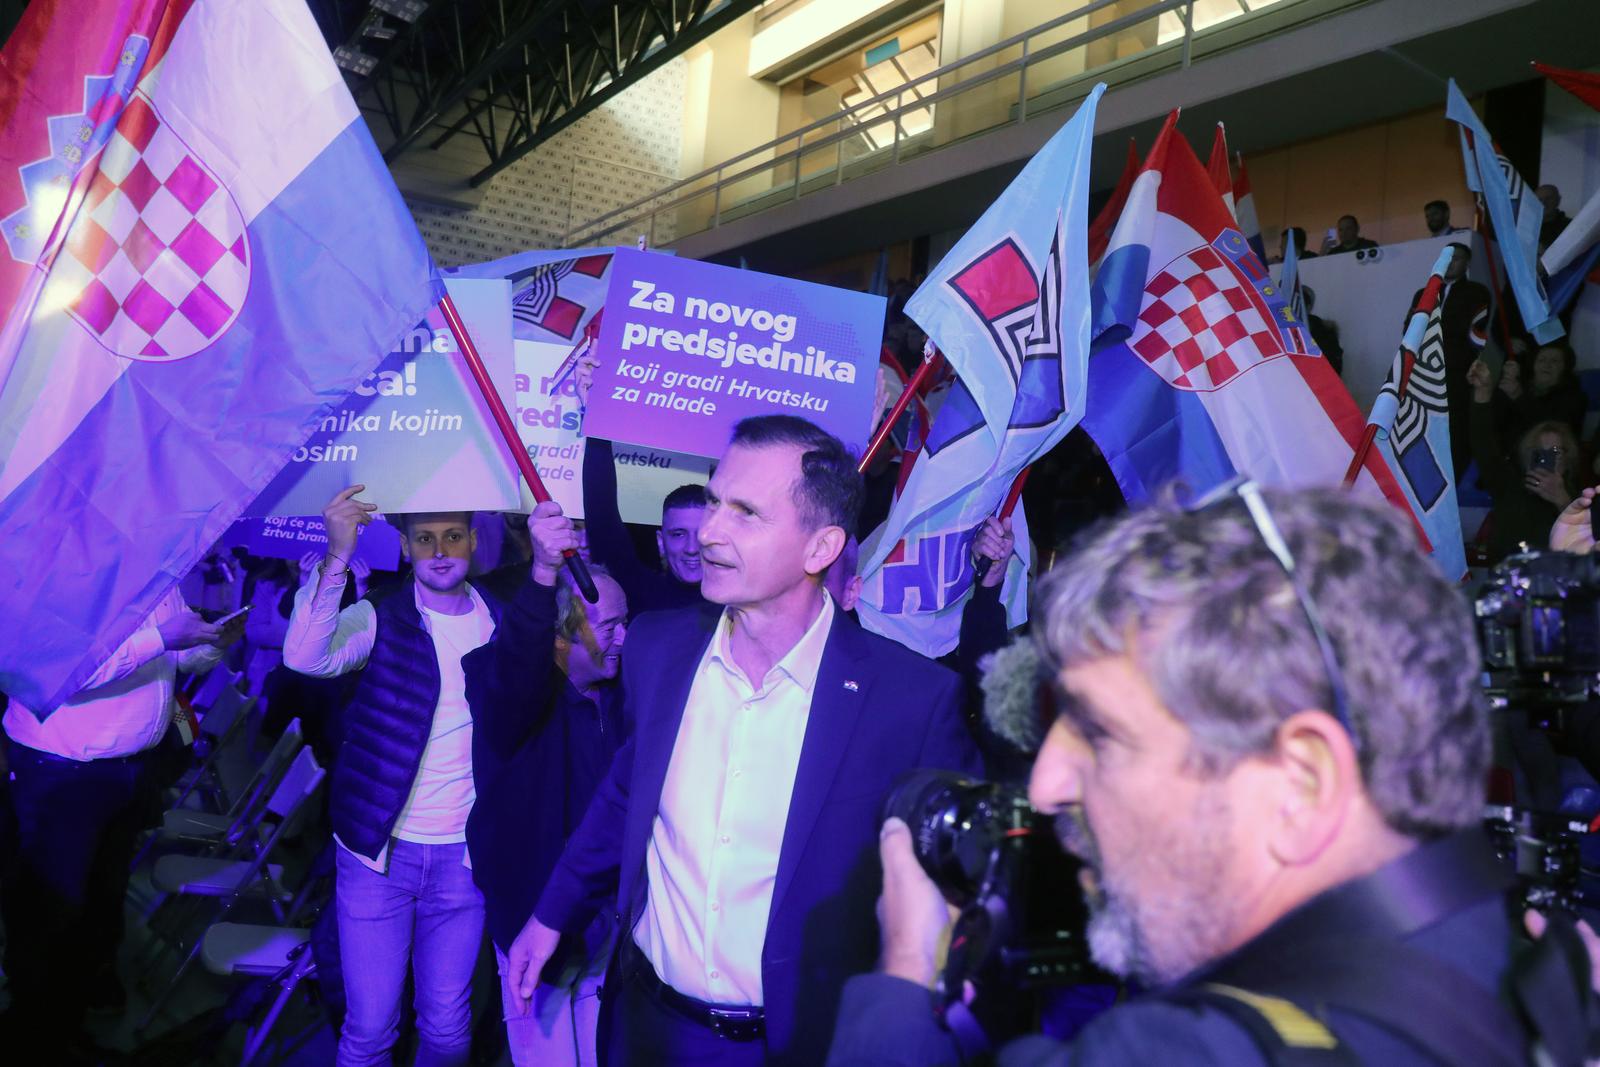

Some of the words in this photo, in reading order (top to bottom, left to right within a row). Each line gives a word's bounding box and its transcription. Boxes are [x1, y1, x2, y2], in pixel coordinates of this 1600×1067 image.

[629, 280, 675, 314] Za
[684, 297, 797, 342] novog
[392, 327, 458, 353] na
[621, 322, 856, 384] predsjednika
[616, 359, 660, 384] koji
[661, 370, 725, 392] gradi
[727, 379, 829, 412] Hrvatsku
[611, 386, 640, 402] za
[645, 391, 716, 415] mlade
[313, 410, 381, 432] nika
[389, 409, 463, 436] kojim
[262, 527, 295, 539] žrtvu
